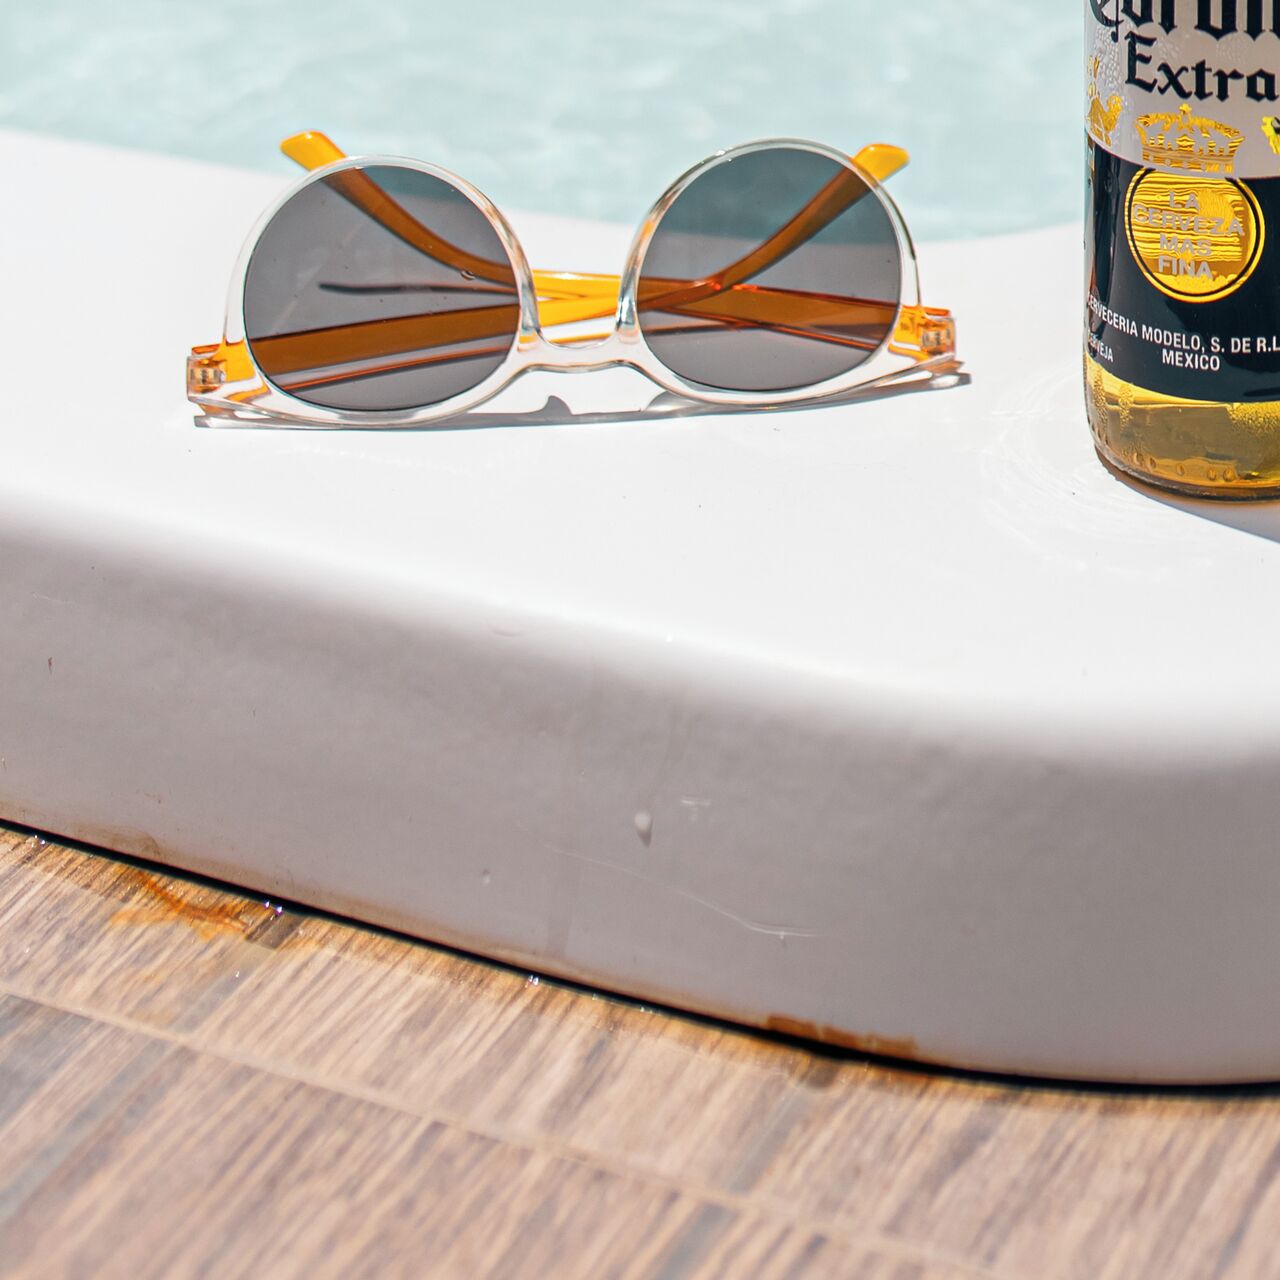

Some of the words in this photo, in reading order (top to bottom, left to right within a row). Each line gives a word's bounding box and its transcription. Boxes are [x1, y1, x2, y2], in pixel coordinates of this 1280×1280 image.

[1125, 31, 1279, 102] Extra
[1169, 190, 1200, 211] LA
[1133, 204, 1245, 237] CERVEZA
[1159, 233, 1212, 257] MAS
[1158, 255, 1214, 280] FINA
[1142, 324, 1206, 353] MODELO,
[1211, 337, 1225, 353] S.
[1231, 337, 1251, 353] DE
[1162, 349, 1221, 372] MEXICO
